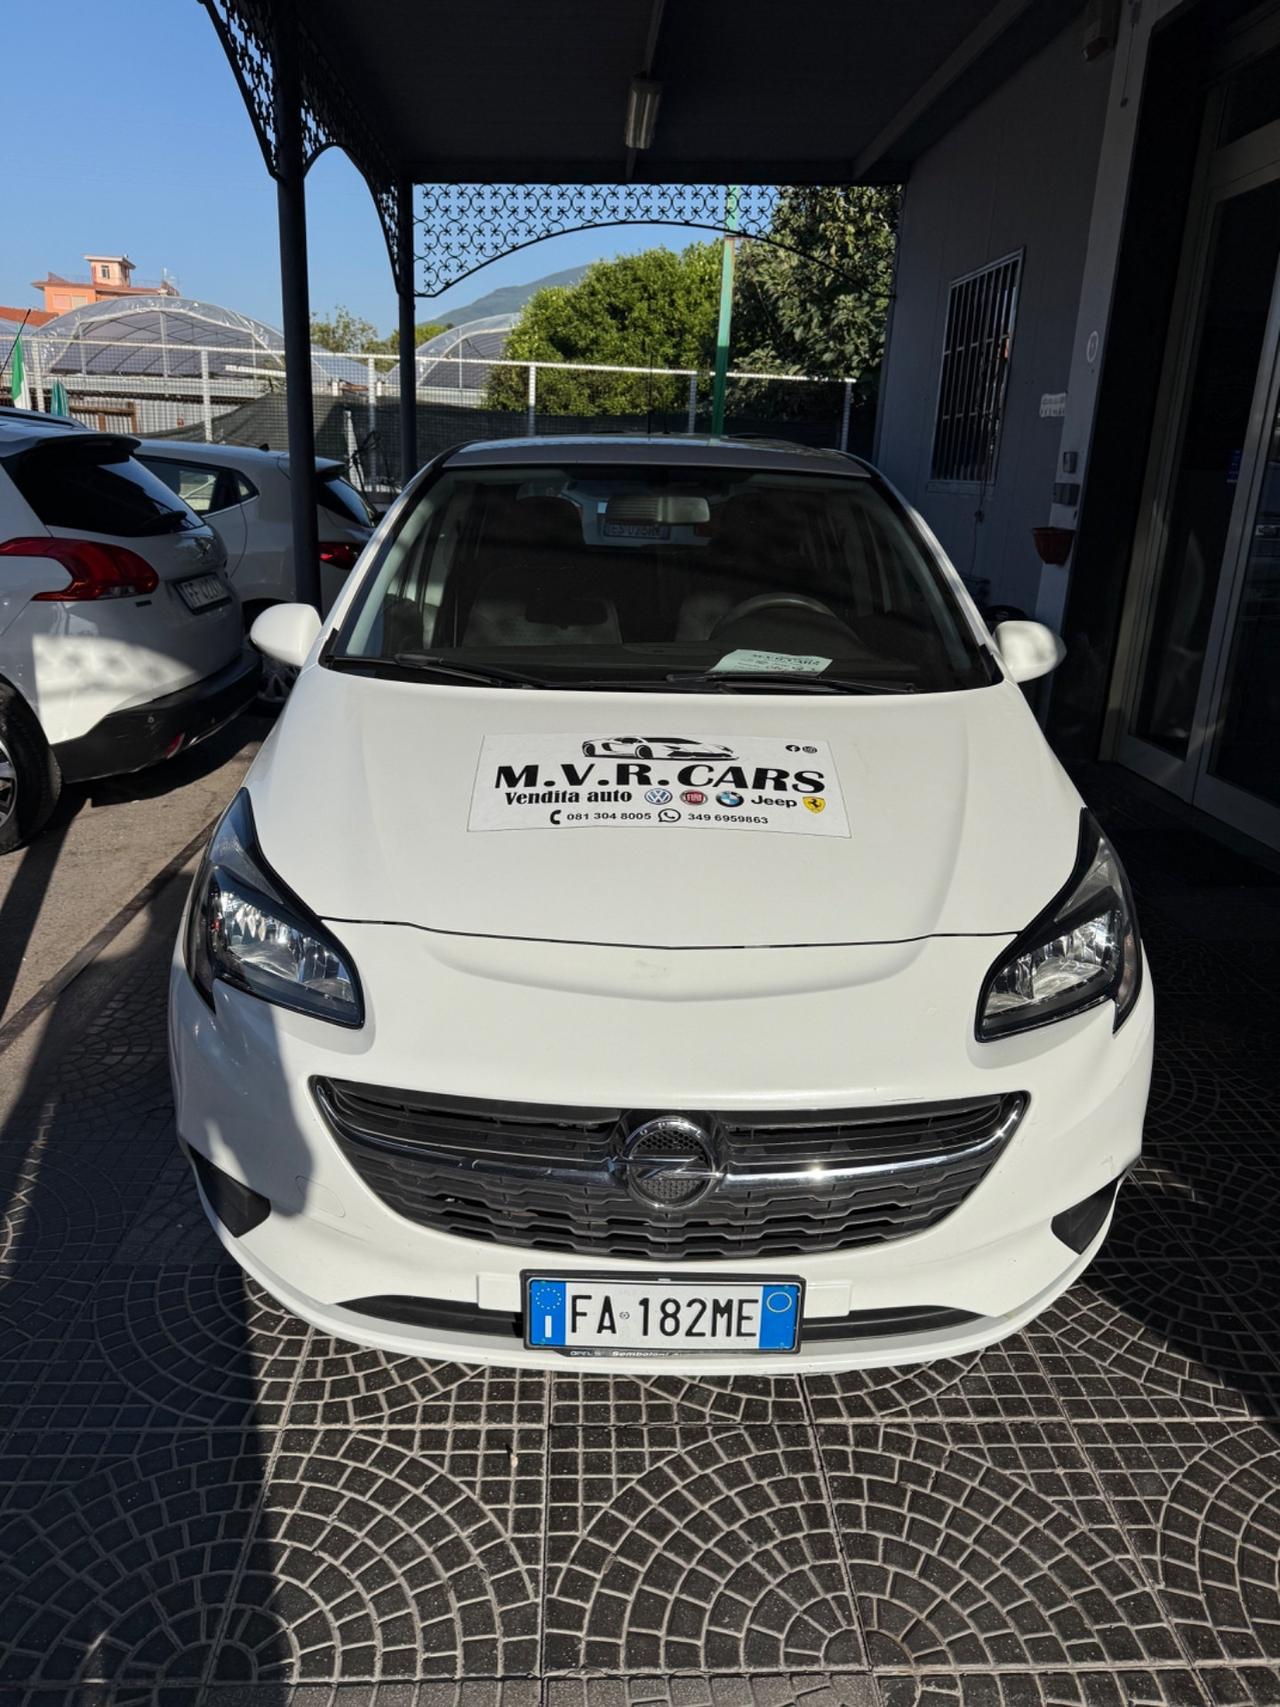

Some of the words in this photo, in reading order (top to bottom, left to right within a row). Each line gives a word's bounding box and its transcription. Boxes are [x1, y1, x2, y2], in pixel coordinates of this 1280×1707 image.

[505, 790, 580, 805] Vendita
[587, 789, 632, 802] auto
[751, 795, 797, 808] Jeep
[594, 812, 617, 820] 304
[620, 812, 651, 820] 8005
[688, 813, 711, 821] 349
[714, 814, 769, 824] 6959863
[571, 1295, 617, 1334] FA
[638, 1297, 759, 1337] 182ME
[545, 1315, 552, 1338] I
